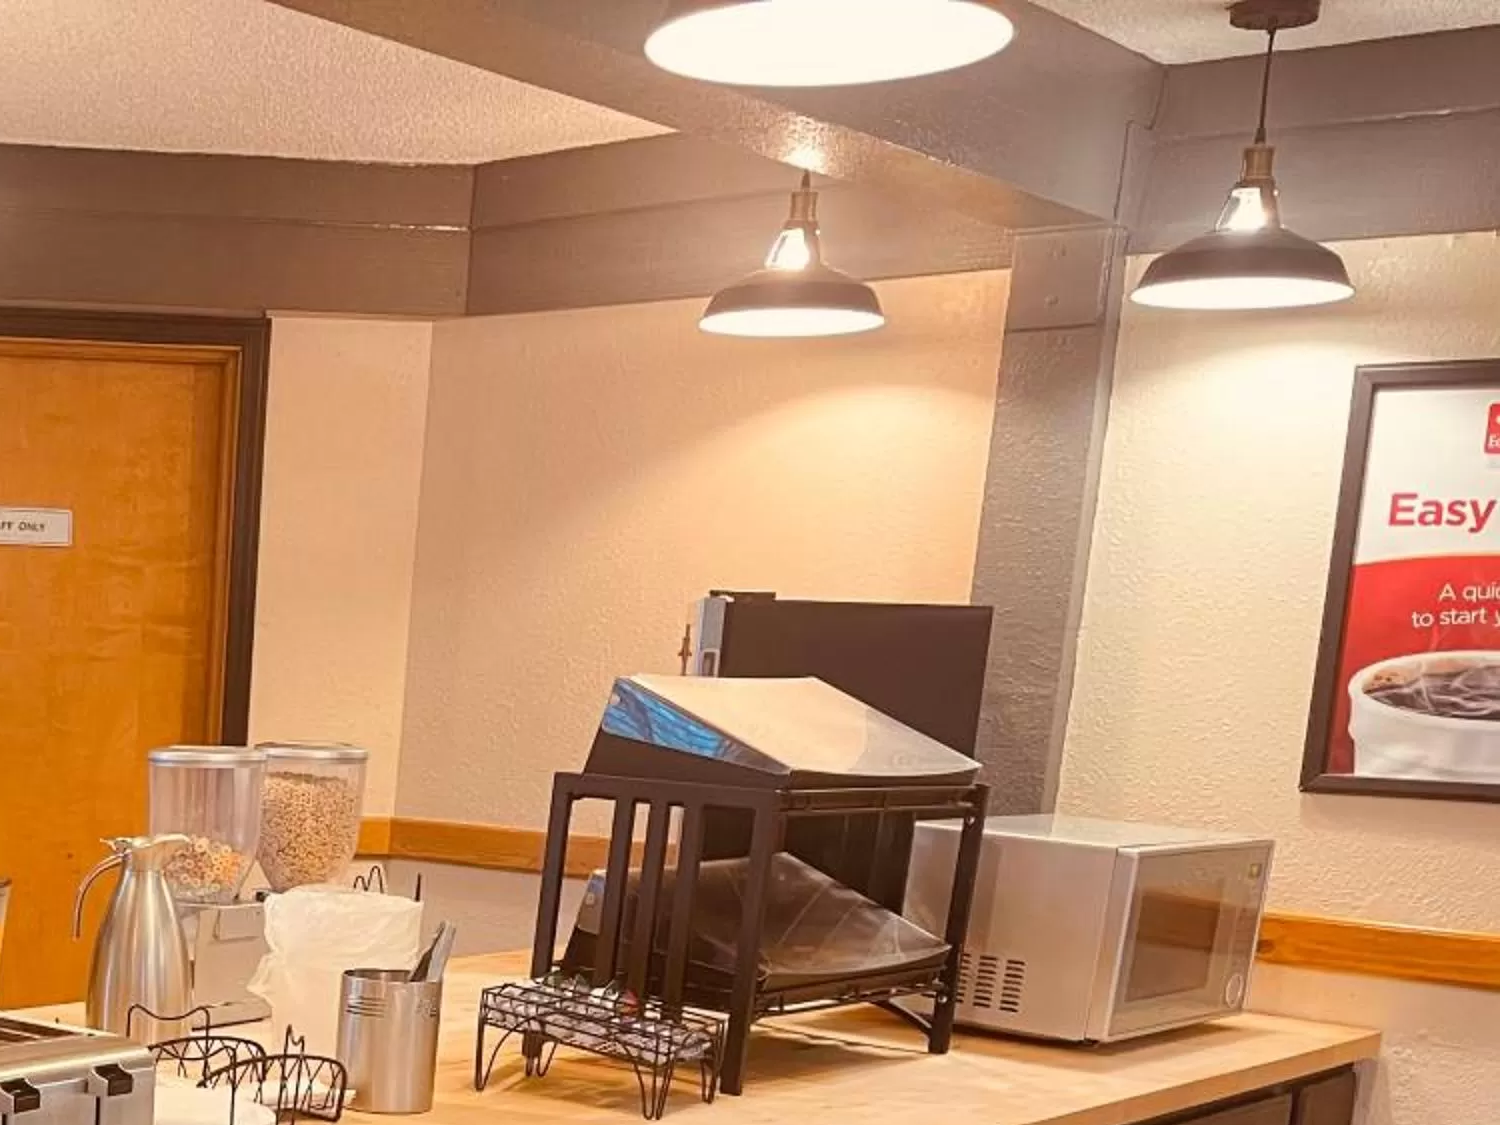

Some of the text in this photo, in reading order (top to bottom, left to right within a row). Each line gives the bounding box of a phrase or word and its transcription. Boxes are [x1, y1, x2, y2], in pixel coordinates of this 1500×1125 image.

[1388, 491, 1498, 534] Easy
[17, 521, 45, 532] ONLY
[1438, 582, 1457, 602] A
[1410, 610, 1435, 629] to
[1438, 606, 1488, 626] start
